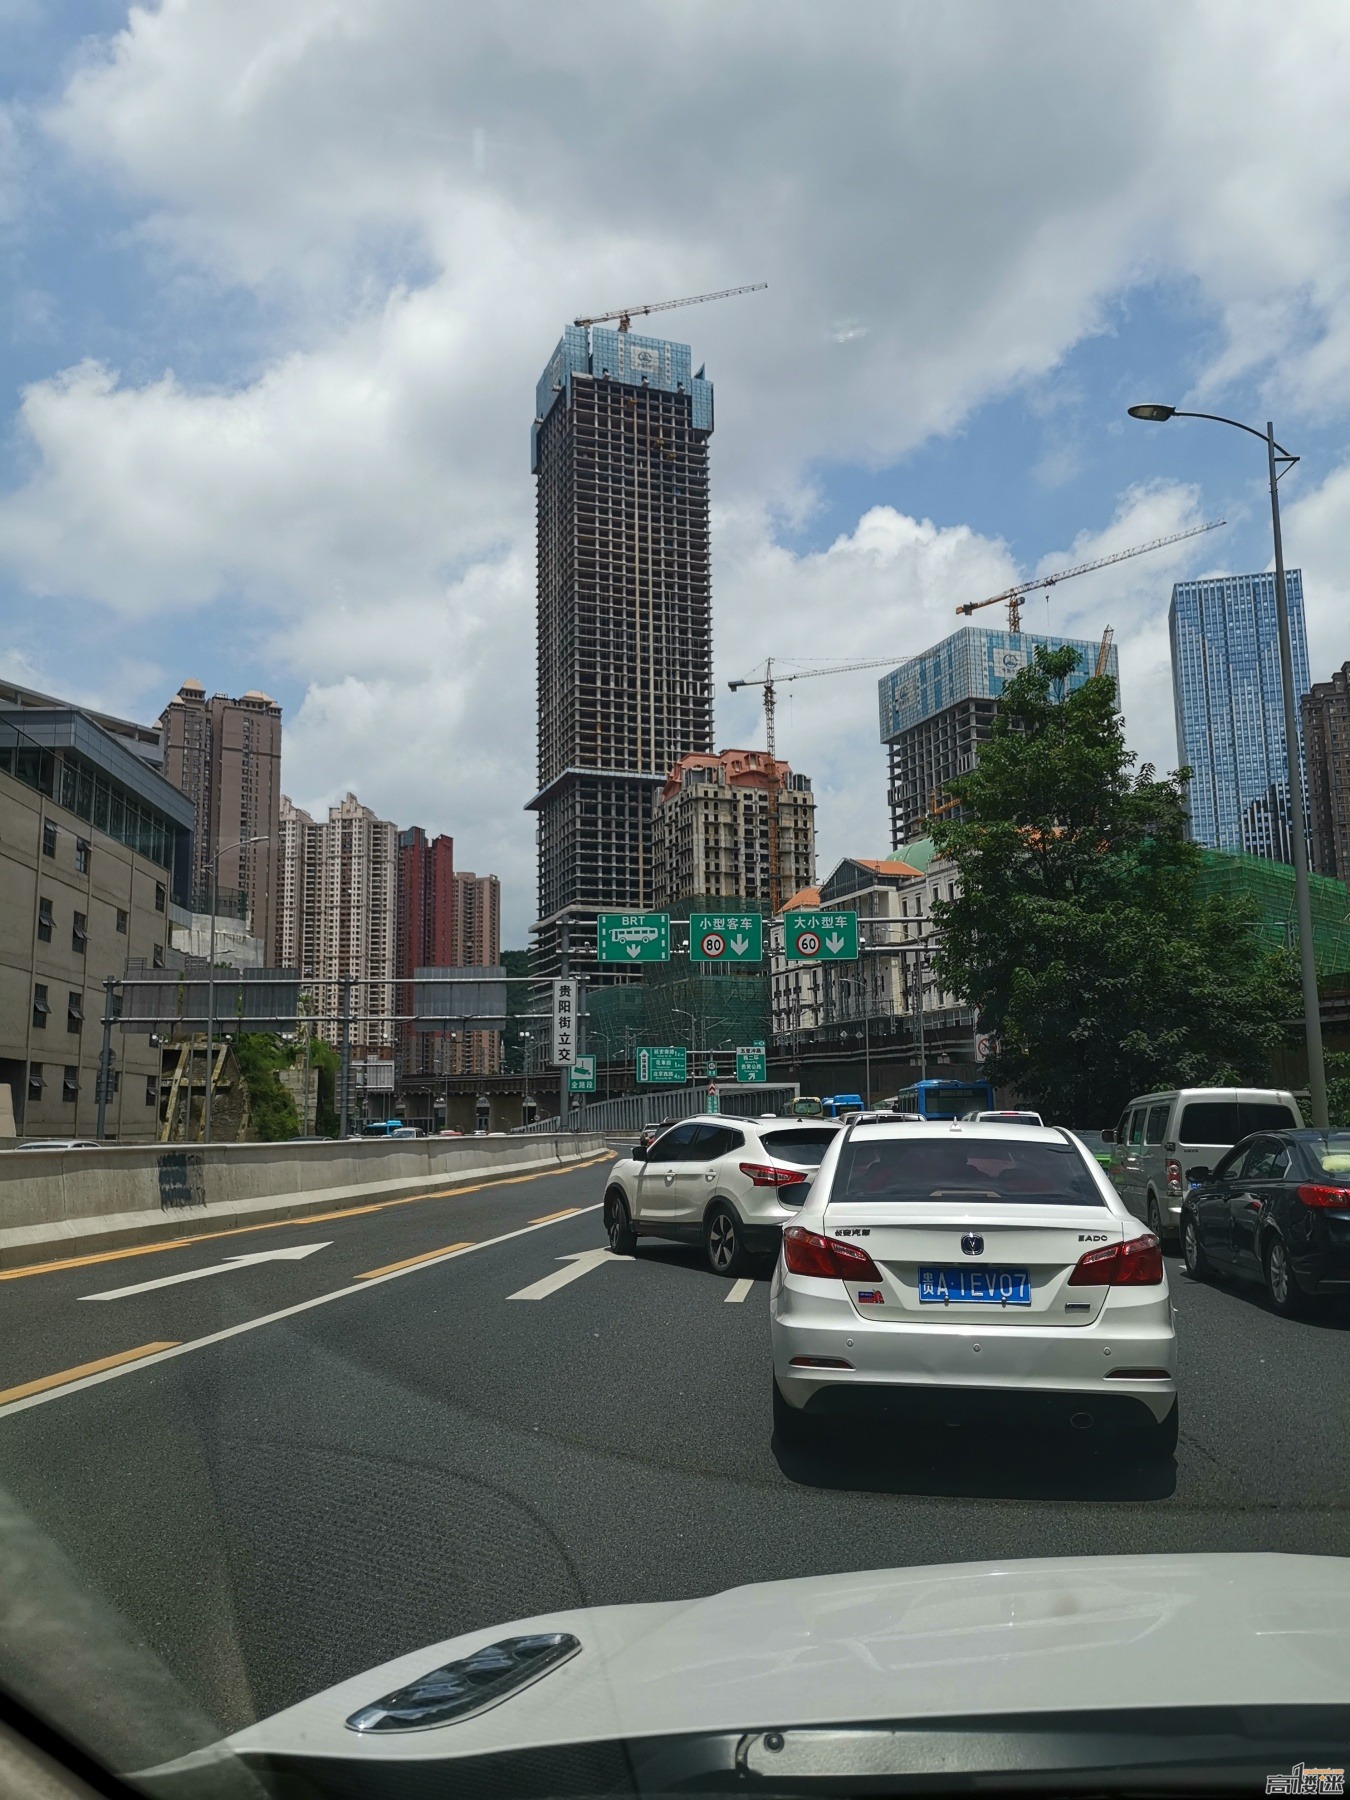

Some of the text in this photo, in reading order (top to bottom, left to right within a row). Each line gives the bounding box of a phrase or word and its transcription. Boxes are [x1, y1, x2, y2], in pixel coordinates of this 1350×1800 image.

[622, 916, 645, 926] BRT
[700, 917, 753, 930] 小型客车
[794, 916, 848, 929] 大小型车
[706, 939, 721, 951] 80
[801, 938, 815, 950] 60
[558, 985, 571, 1061] 贵阳街立交
[571, 1081, 593, 1089] 全路段
[1078, 1234, 1108, 1242] EADO
